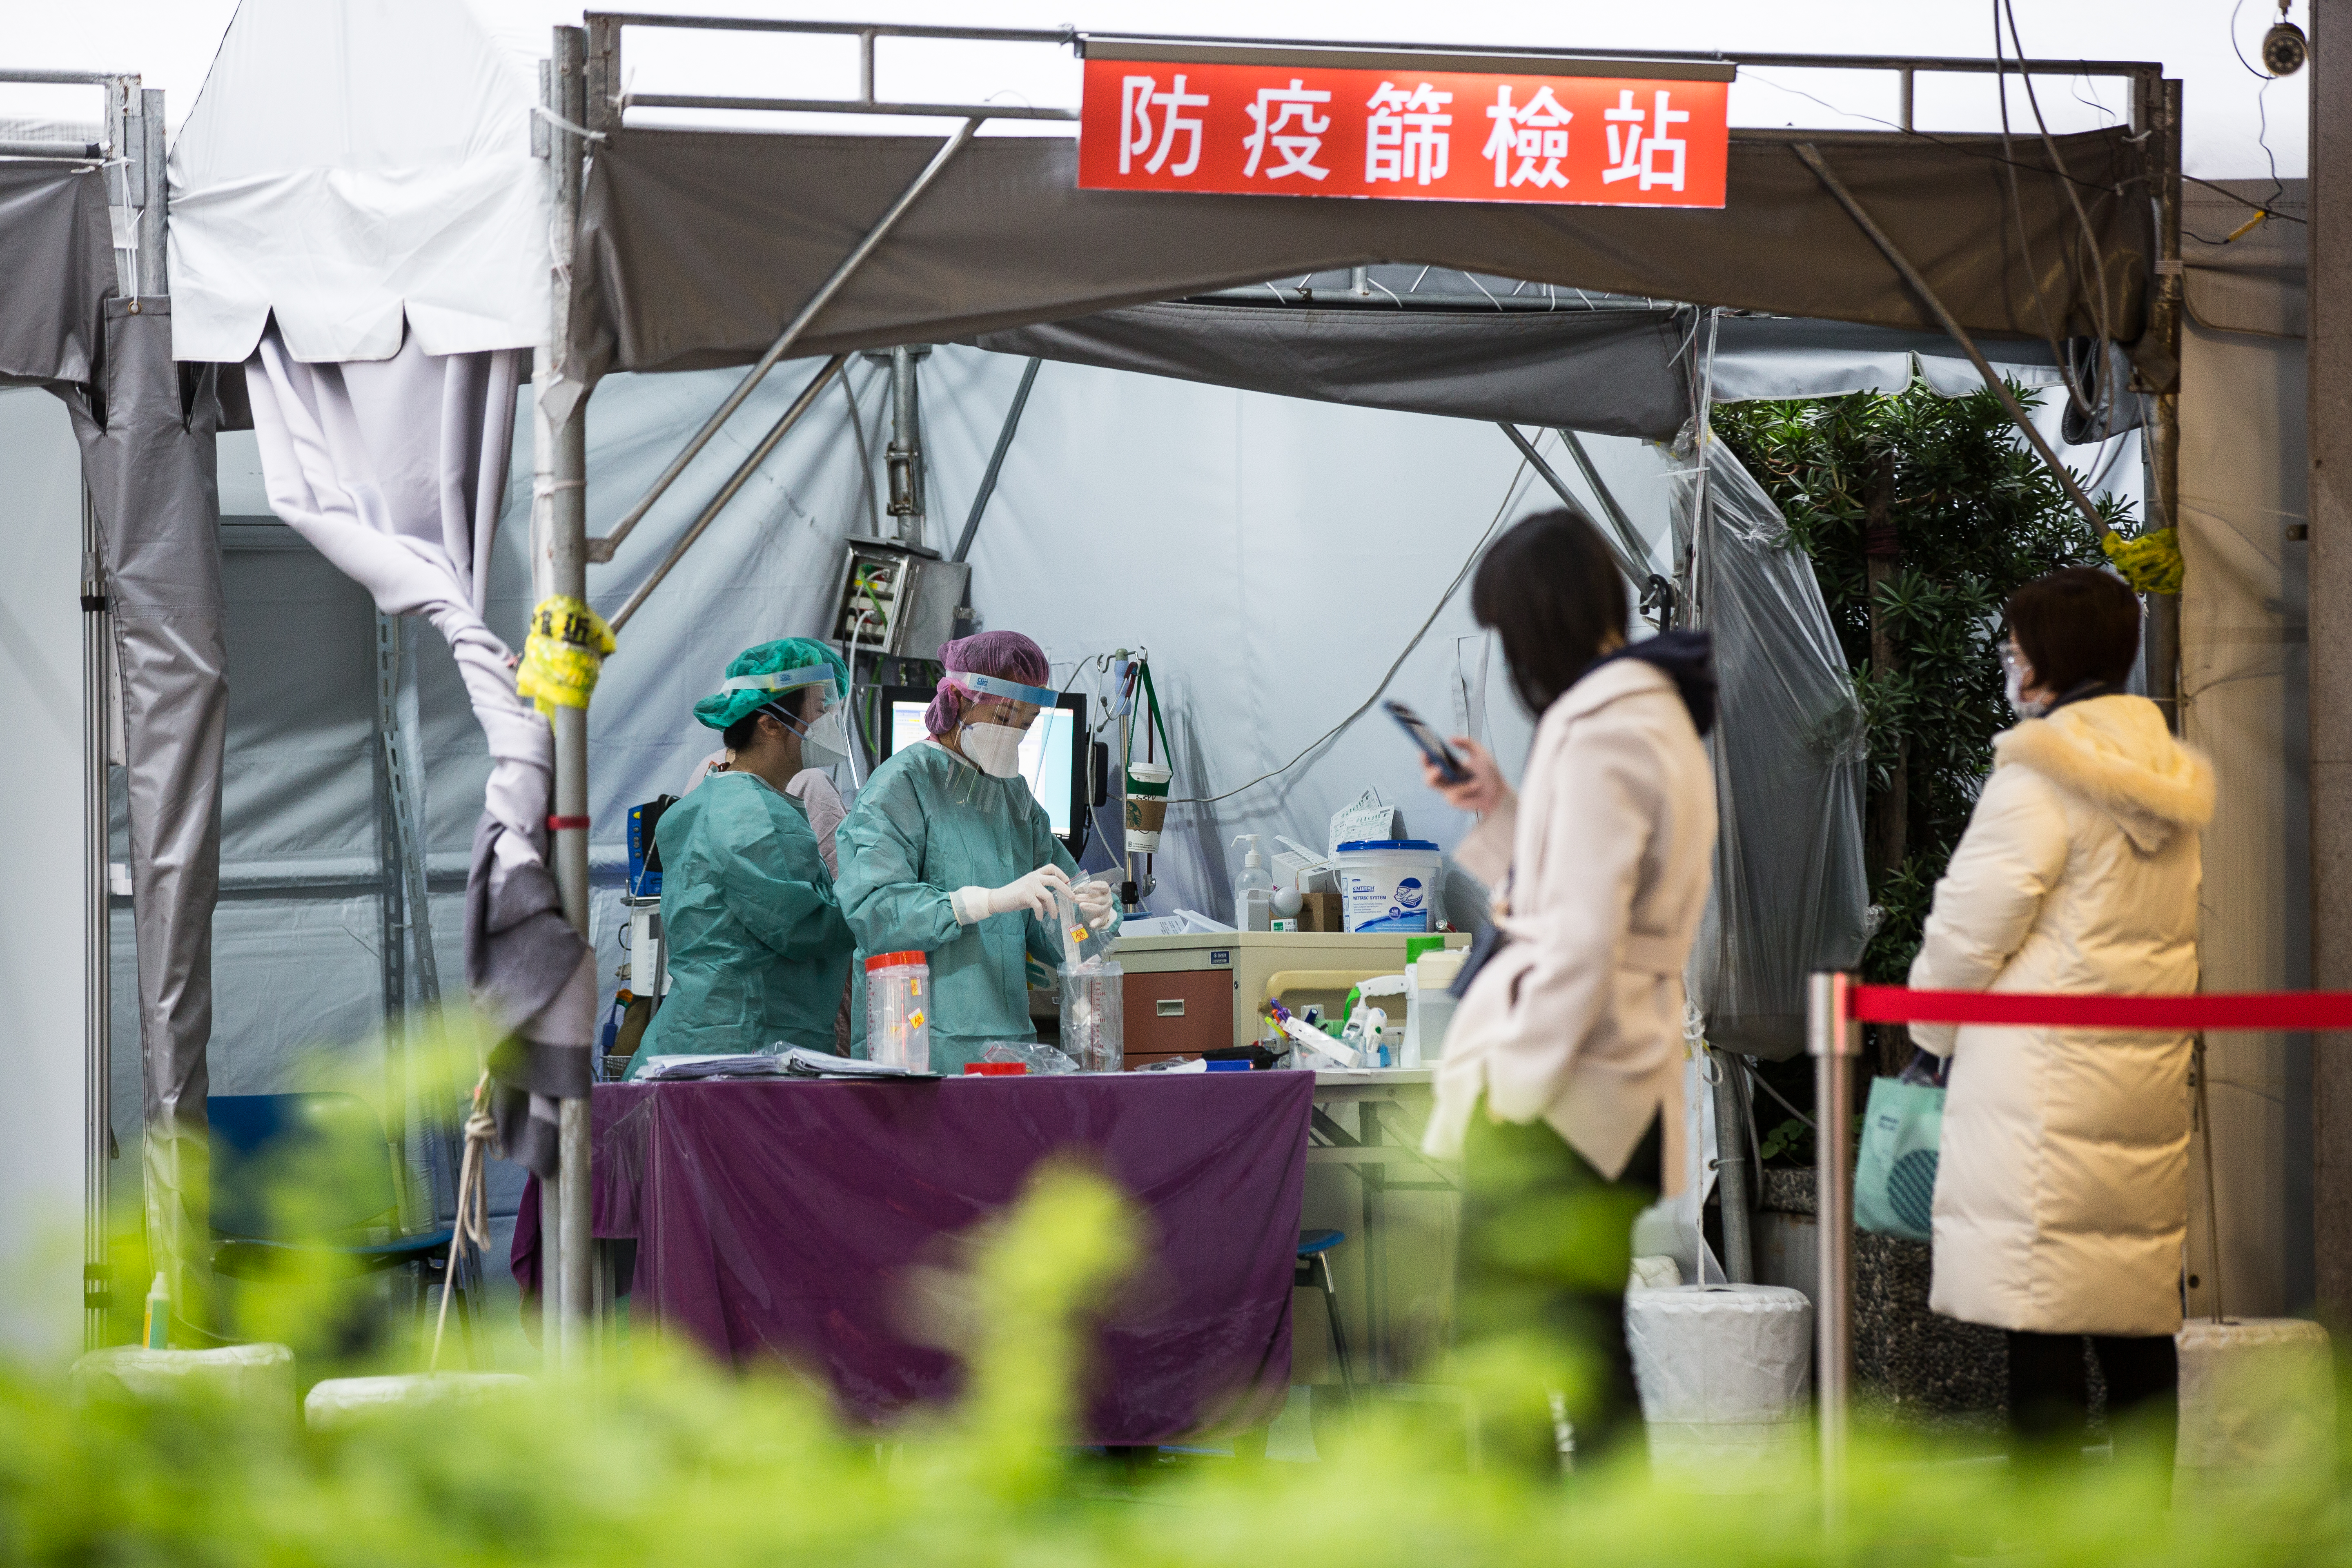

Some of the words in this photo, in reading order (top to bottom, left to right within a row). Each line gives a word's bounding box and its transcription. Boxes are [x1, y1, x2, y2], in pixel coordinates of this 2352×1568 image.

[1118, 74, 1690, 192] 防疫篩檢站
